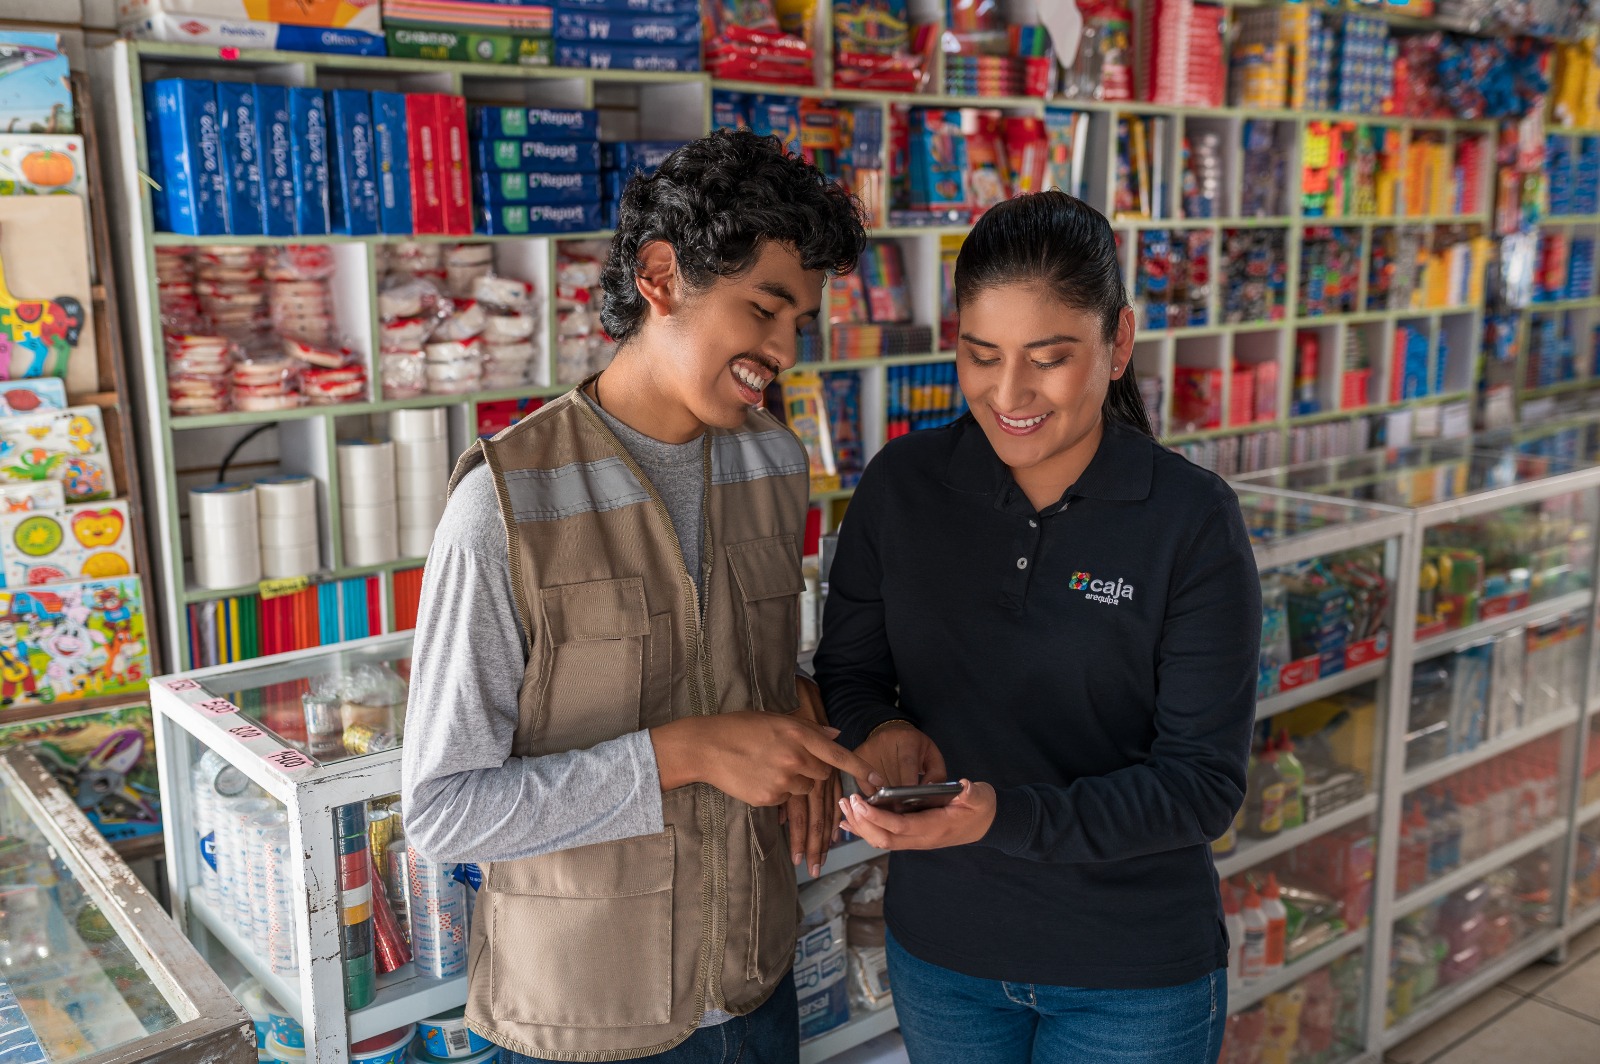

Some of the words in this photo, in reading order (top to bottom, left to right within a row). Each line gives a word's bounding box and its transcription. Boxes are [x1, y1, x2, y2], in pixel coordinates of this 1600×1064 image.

[198, 115, 218, 171] eclipse
[235, 106, 254, 161] eclipse
[270, 123, 288, 177] eclipse
[306, 109, 323, 162] eclipse
[351, 125, 369, 178] eclipse
[1085, 593, 1119, 606] arequipa
[1090, 577, 1134, 601] caja
[228, 725, 262, 738] 800
[268, 749, 307, 768] 1400
